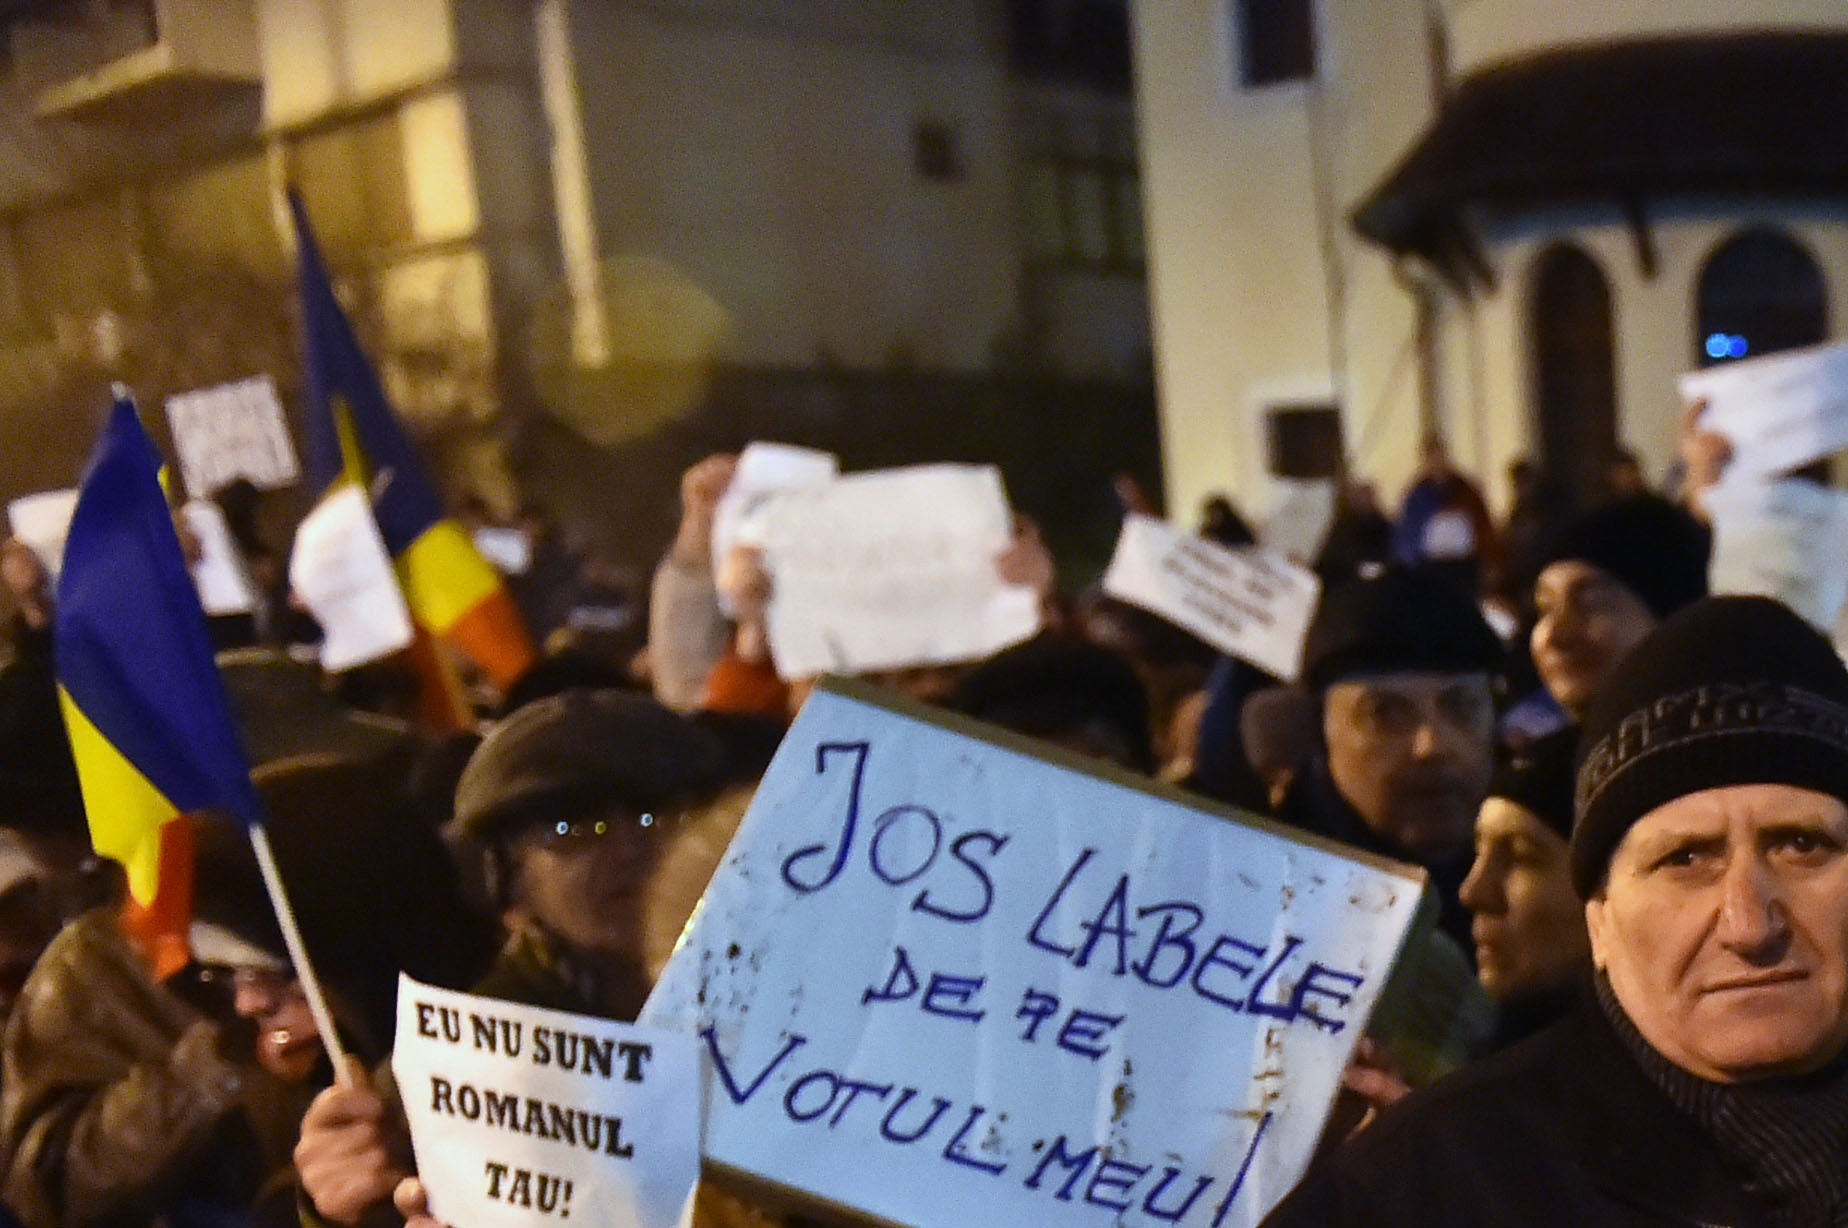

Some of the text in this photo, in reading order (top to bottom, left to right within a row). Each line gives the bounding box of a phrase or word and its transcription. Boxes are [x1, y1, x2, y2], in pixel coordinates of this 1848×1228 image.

[781, 741, 1364, 1035] JOS LABELE
[416, 1002, 653, 1086] EU NU SUNT
[861, 945, 1126, 1061] DE PE
[431, 1077, 635, 1161] ROMANUL
[702, 1024, 1008, 1177] VOTUL
[486, 1162, 574, 1218] TAU!
